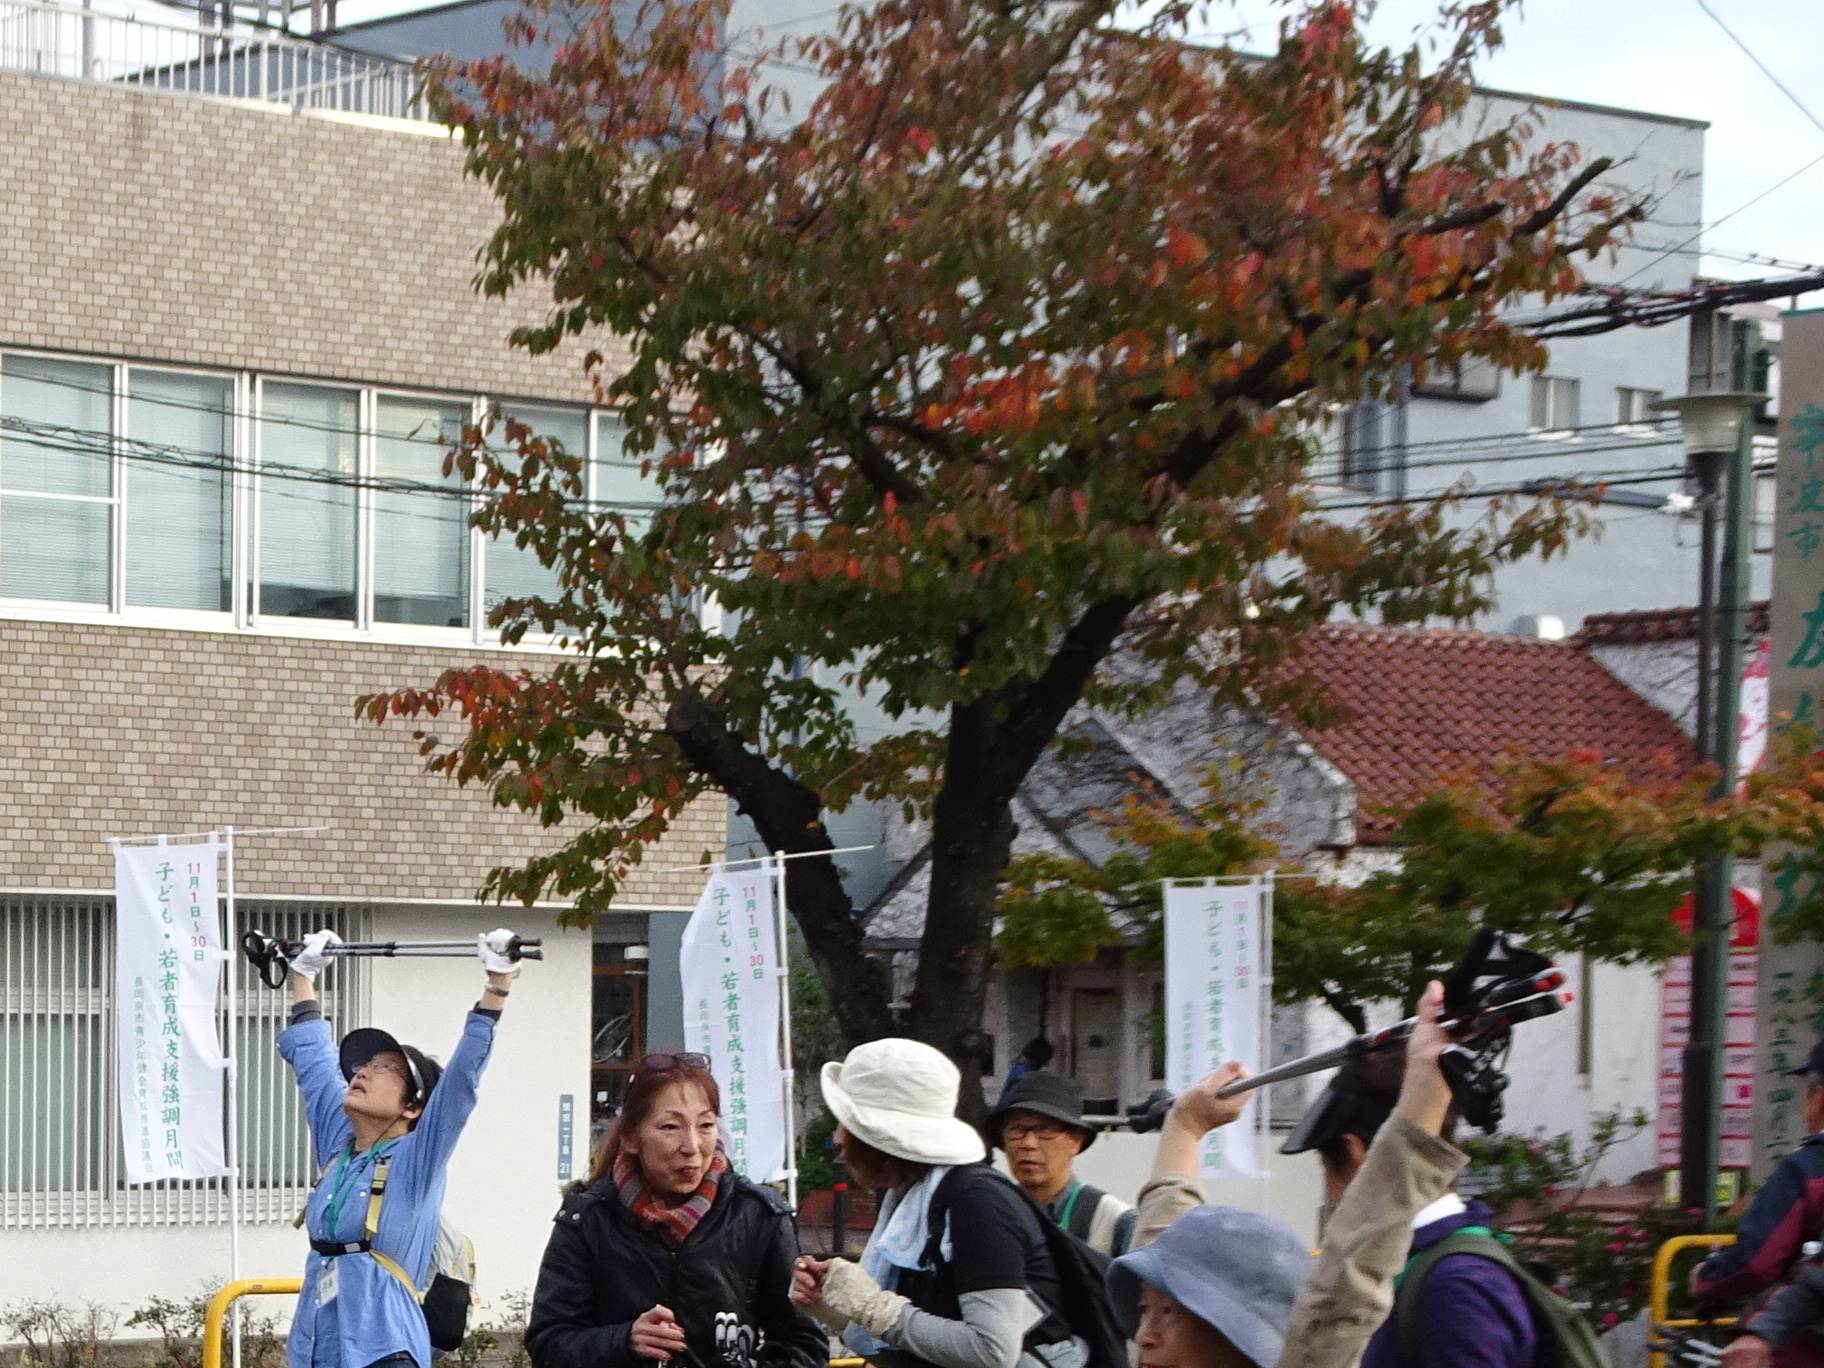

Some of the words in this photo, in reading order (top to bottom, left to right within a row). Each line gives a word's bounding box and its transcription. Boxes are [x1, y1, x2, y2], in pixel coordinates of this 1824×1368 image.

[154, 861, 185, 1171] 子ども・若者育成支援強調月間
